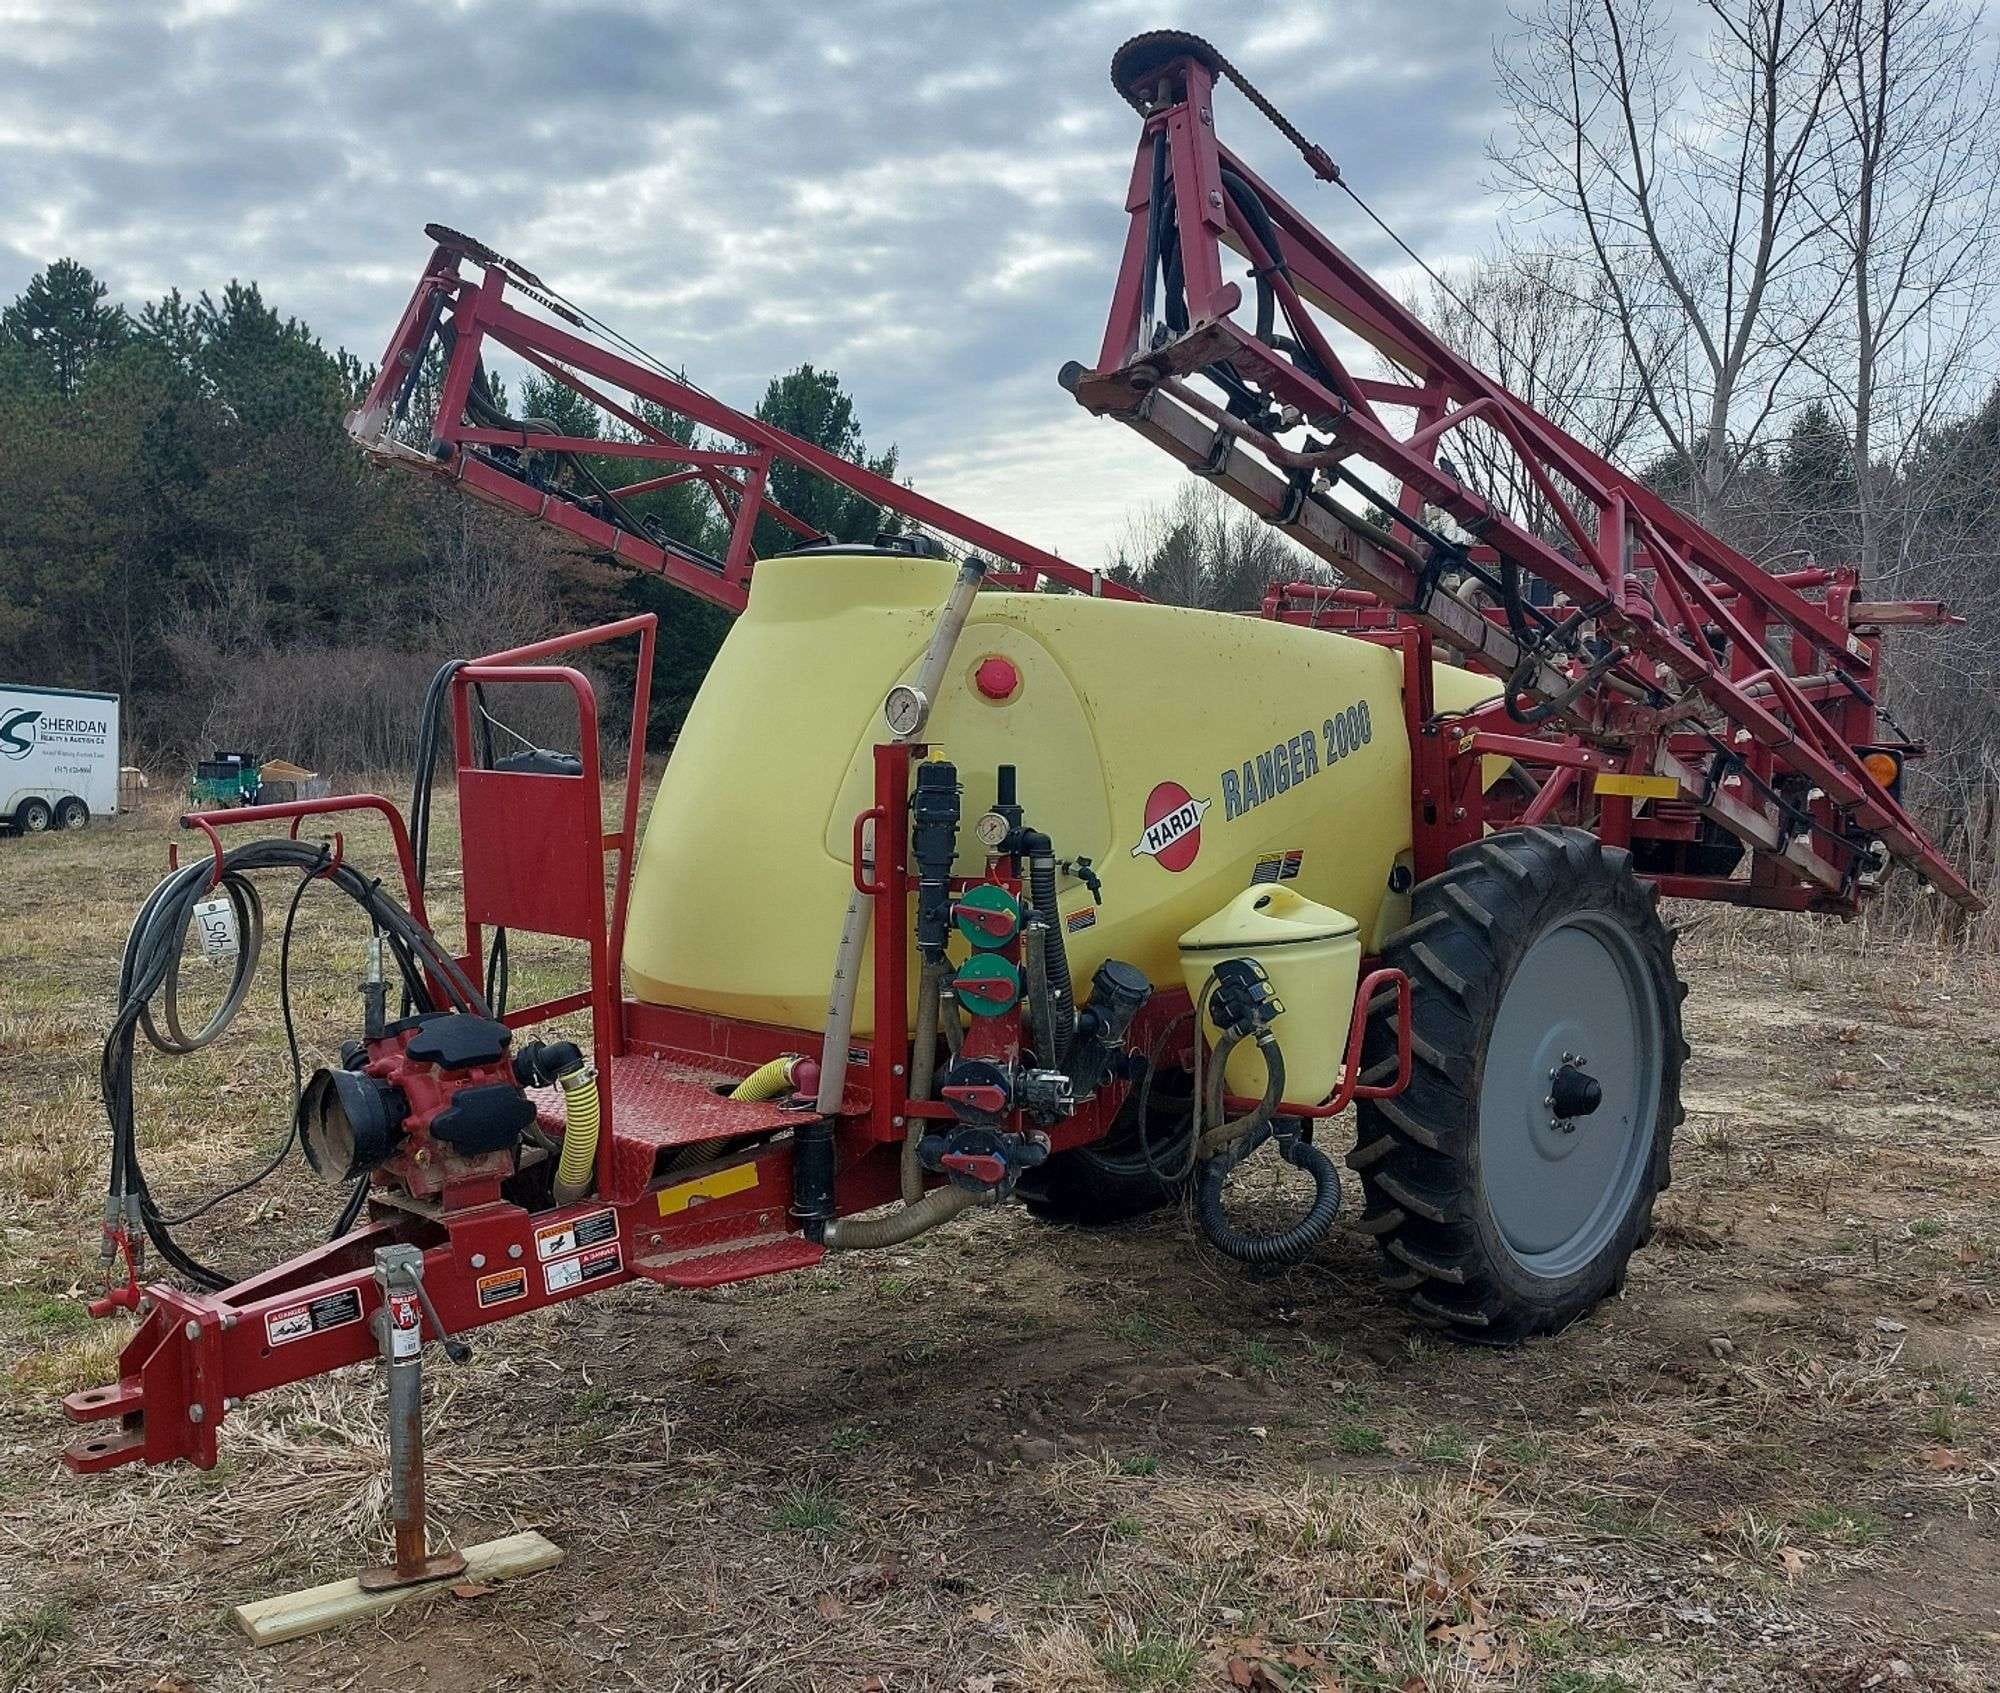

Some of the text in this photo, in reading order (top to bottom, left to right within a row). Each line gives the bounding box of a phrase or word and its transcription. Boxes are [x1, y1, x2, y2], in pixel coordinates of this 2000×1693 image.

[40, 717, 107, 734] SHERIDAN
[1221, 700, 1371, 812] RANGER 2000
[1147, 802, 1199, 850] HARDI
